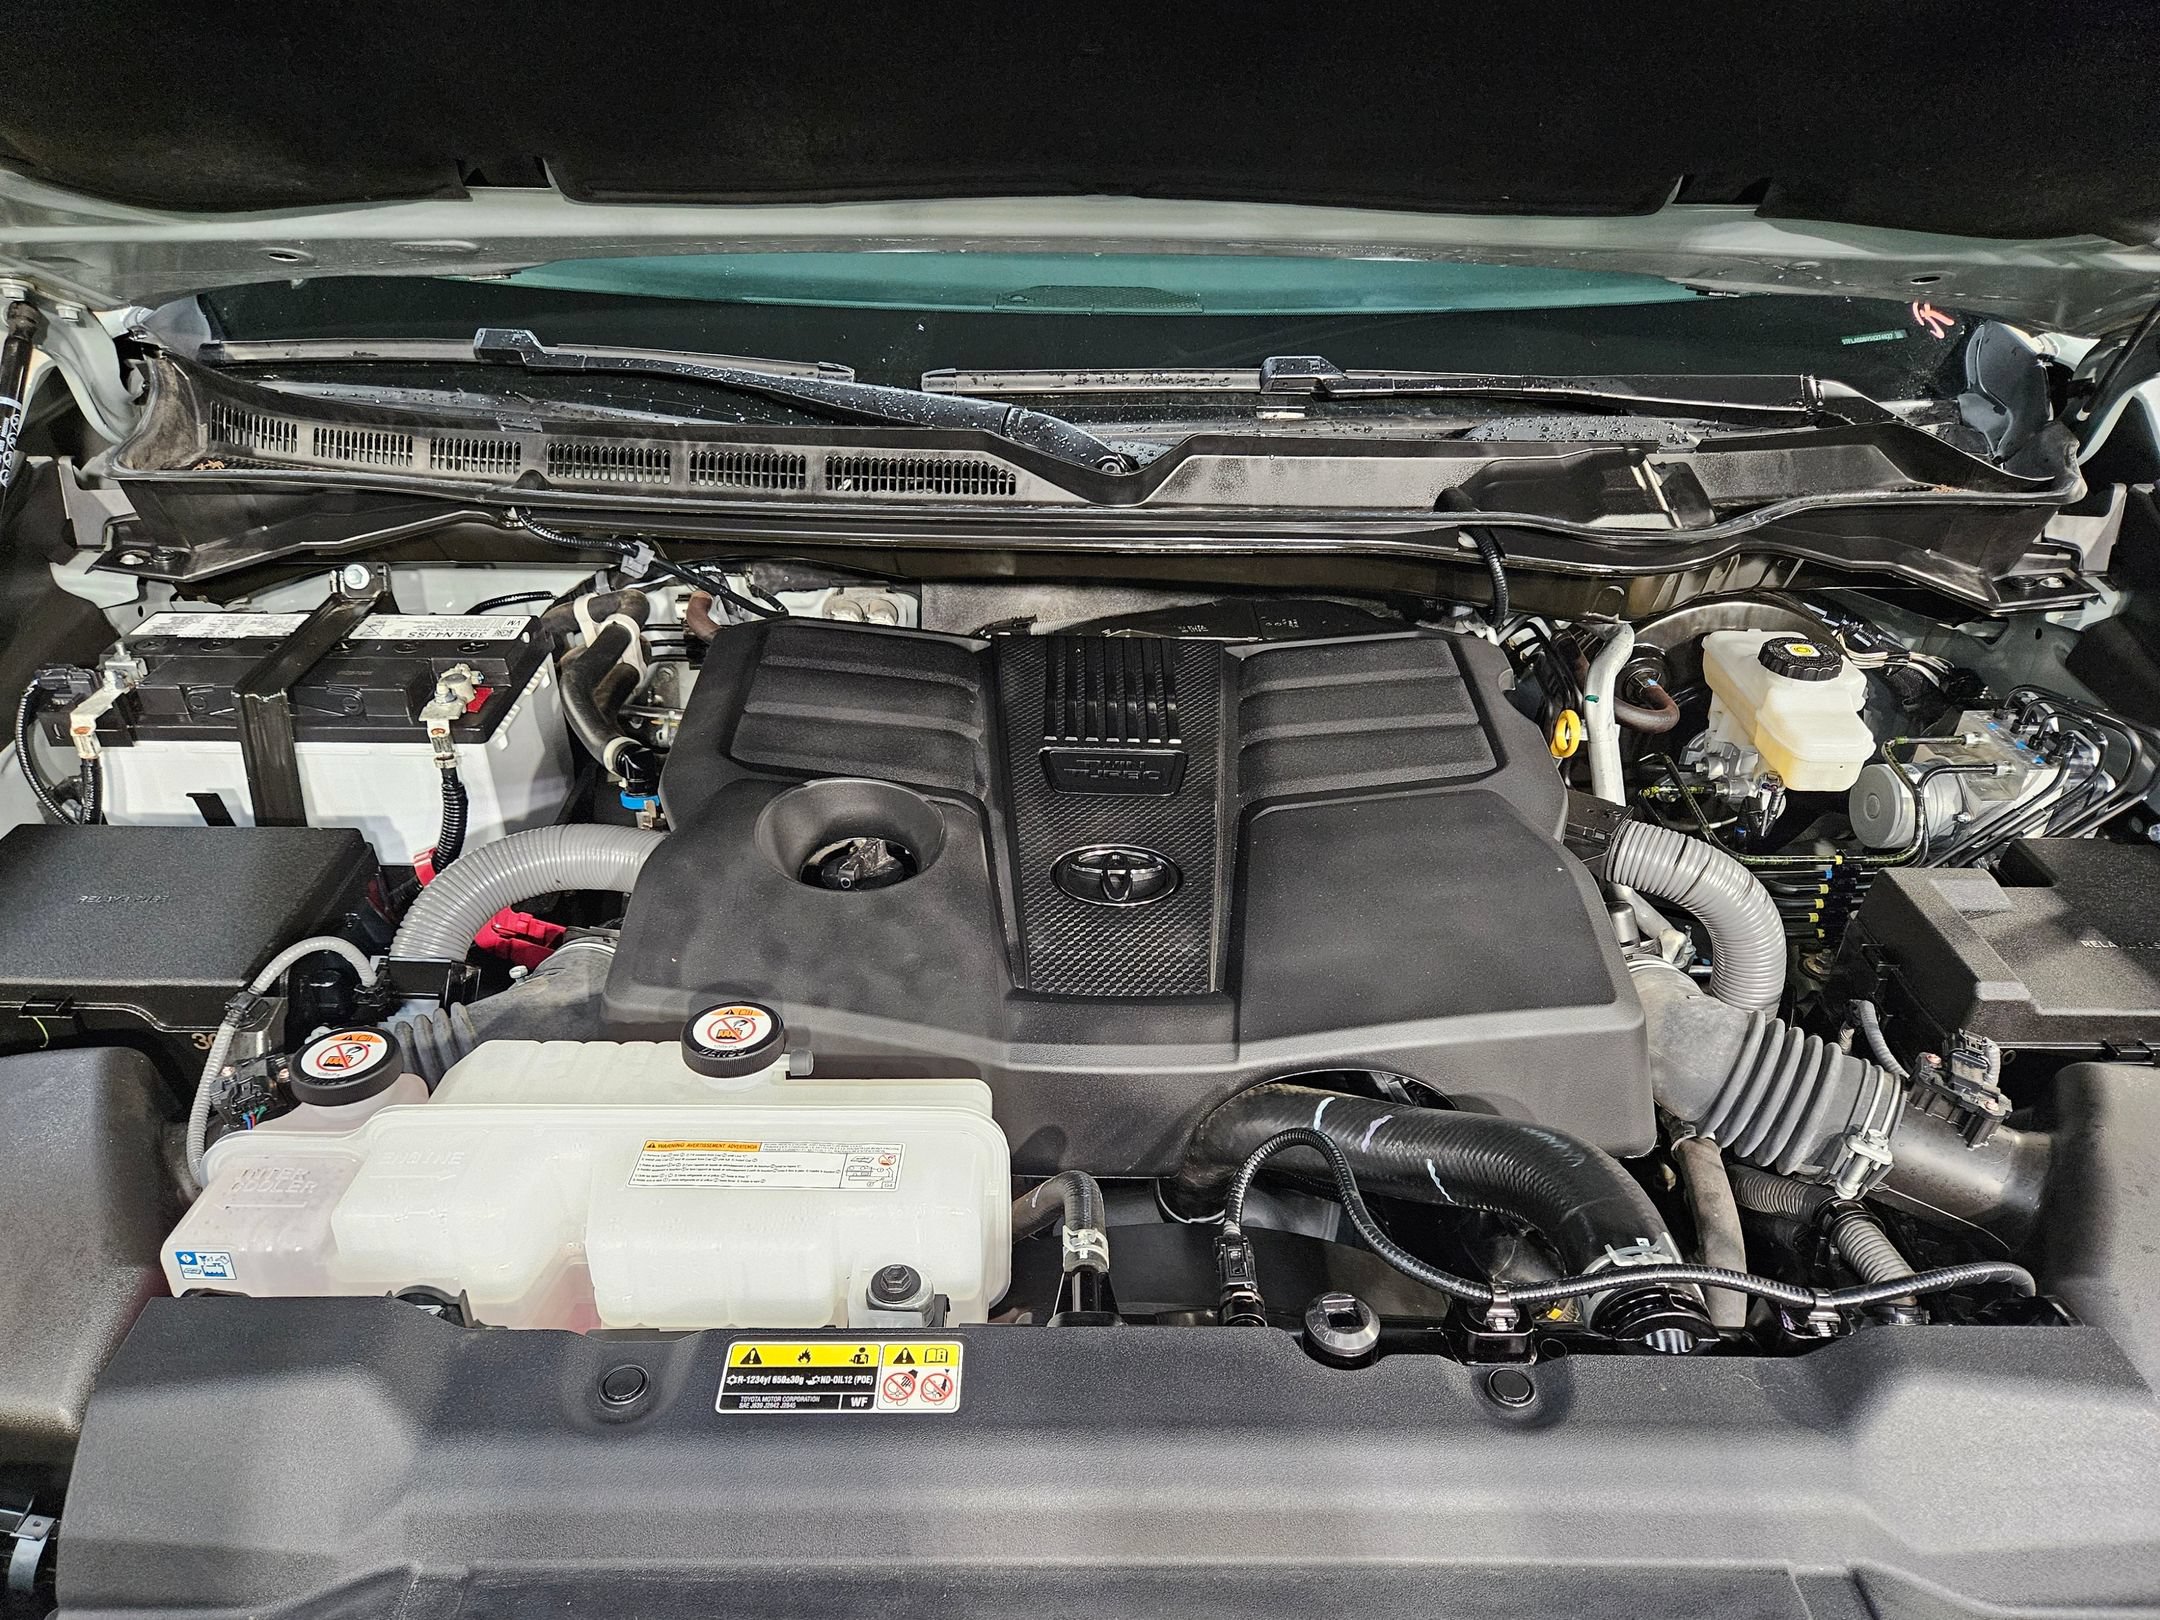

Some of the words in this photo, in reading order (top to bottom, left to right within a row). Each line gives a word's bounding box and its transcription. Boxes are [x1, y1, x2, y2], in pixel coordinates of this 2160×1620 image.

[1063, 768, 1161, 780] TURBO
[2080, 940, 2119, 948] RELA
[238, 1167, 311, 1180] INTER
[231, 1180, 318, 1193] COOLER
[737, 1375, 771, 1385] R-1234yf
[820, 1375, 853, 1385] ND-OIL12
[853, 1375, 874, 1386] (POE)
[850, 1397, 869, 1408] WF
